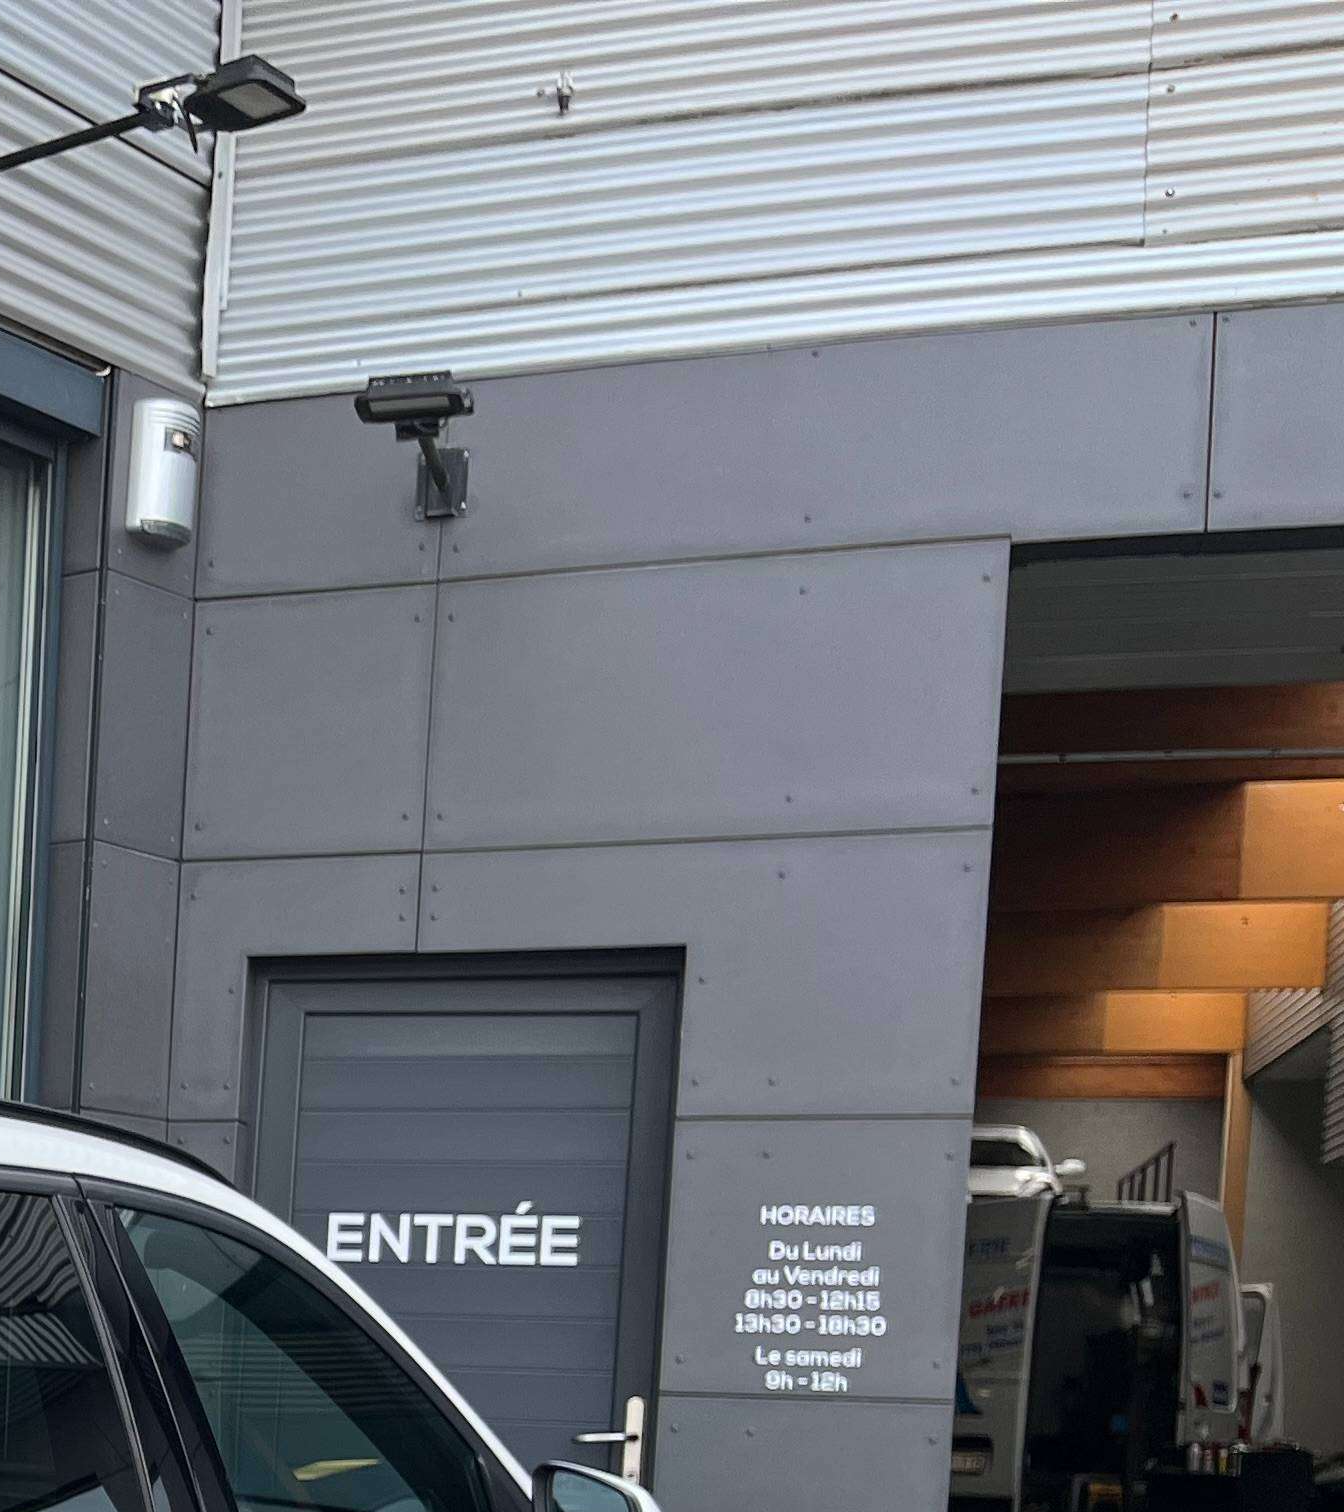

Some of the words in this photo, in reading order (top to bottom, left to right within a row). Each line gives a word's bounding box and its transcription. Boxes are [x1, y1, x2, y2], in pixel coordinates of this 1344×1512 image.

[760, 1204, 875, 1226] HORAIRES
[326, 1200, 580, 1267] ENTRÉE
[768, 1240, 800, 1261] Du
[803, 1241, 862, 1261] Lundi
[752, 1269, 779, 1285] au
[783, 1265, 880, 1287] Vendredi
[755, 1345, 781, 1366] Le
[785, 1348, 862, 1368] samedi
[811, 1371, 849, 1392] 12h
